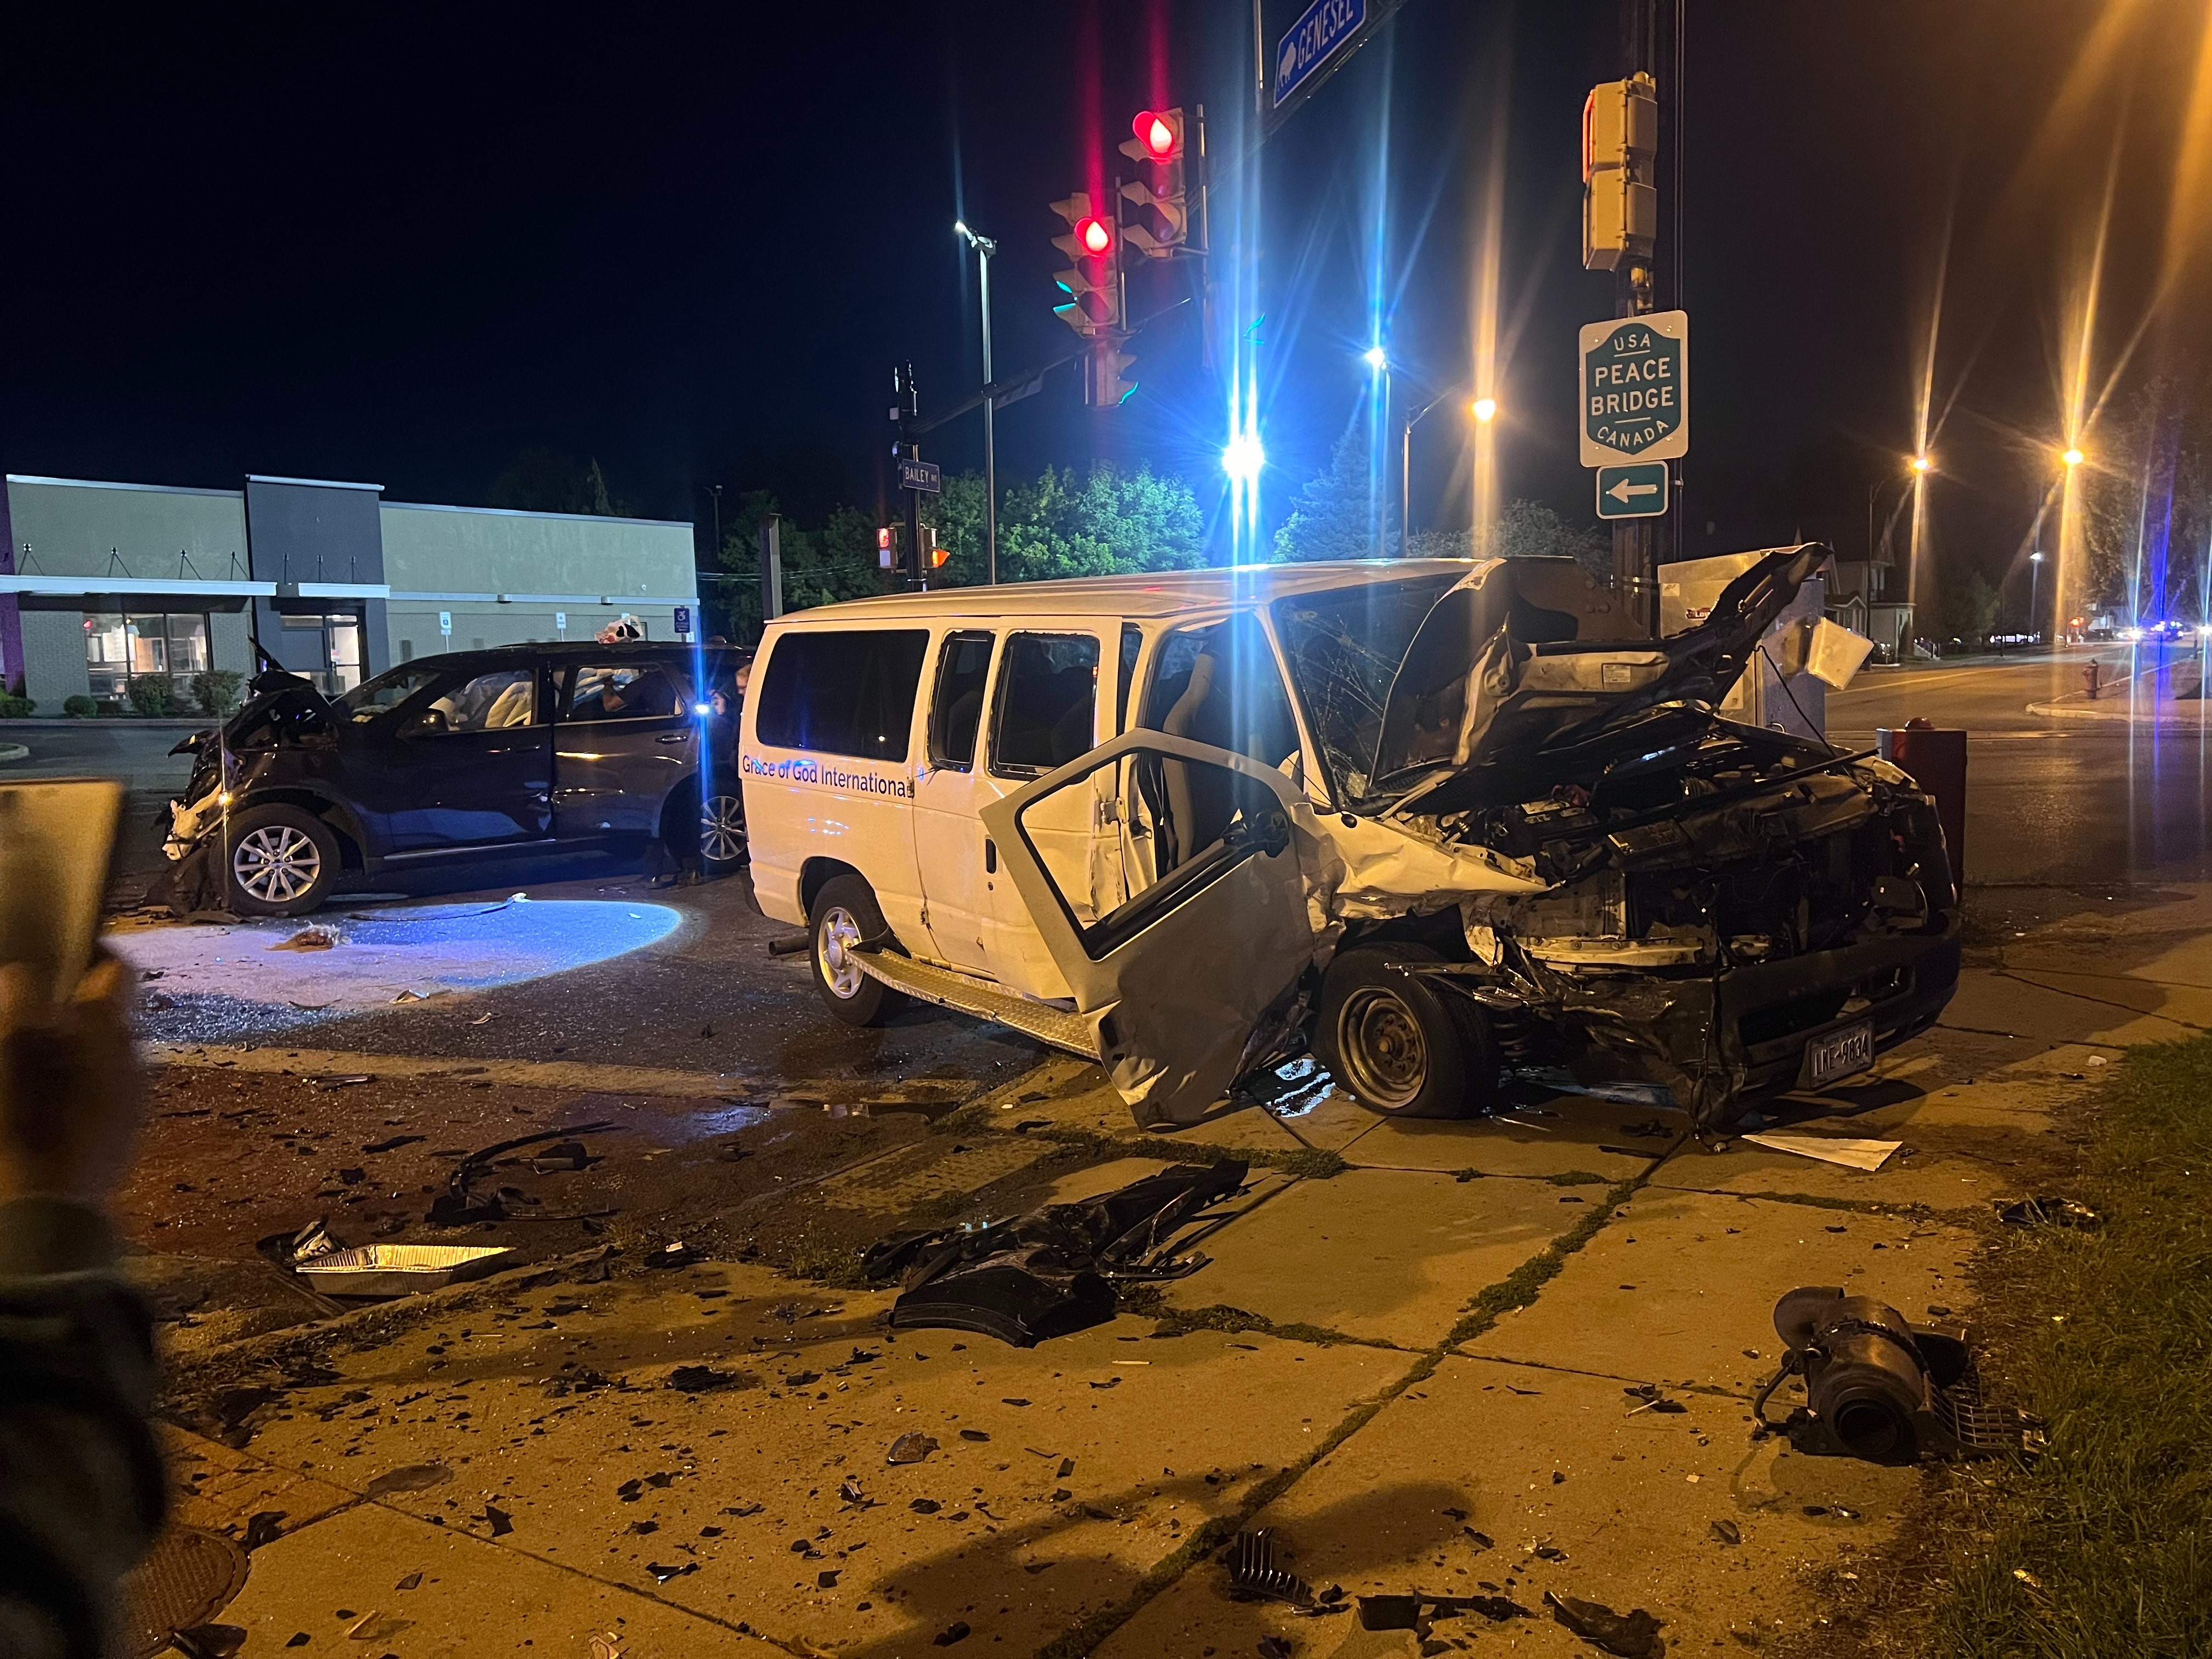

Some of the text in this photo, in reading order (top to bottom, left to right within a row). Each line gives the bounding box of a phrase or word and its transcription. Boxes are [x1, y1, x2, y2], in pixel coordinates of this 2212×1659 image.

[1614, 333, 1651, 352] USA
[1595, 357, 1671, 387] PEACE
[1591, 386, 1674, 416] BRIDGE
[1598, 420, 1669, 448] CANADA
[905, 466, 929, 483] BAILEY
[742, 755, 910, 797] Grace of God Internationa
